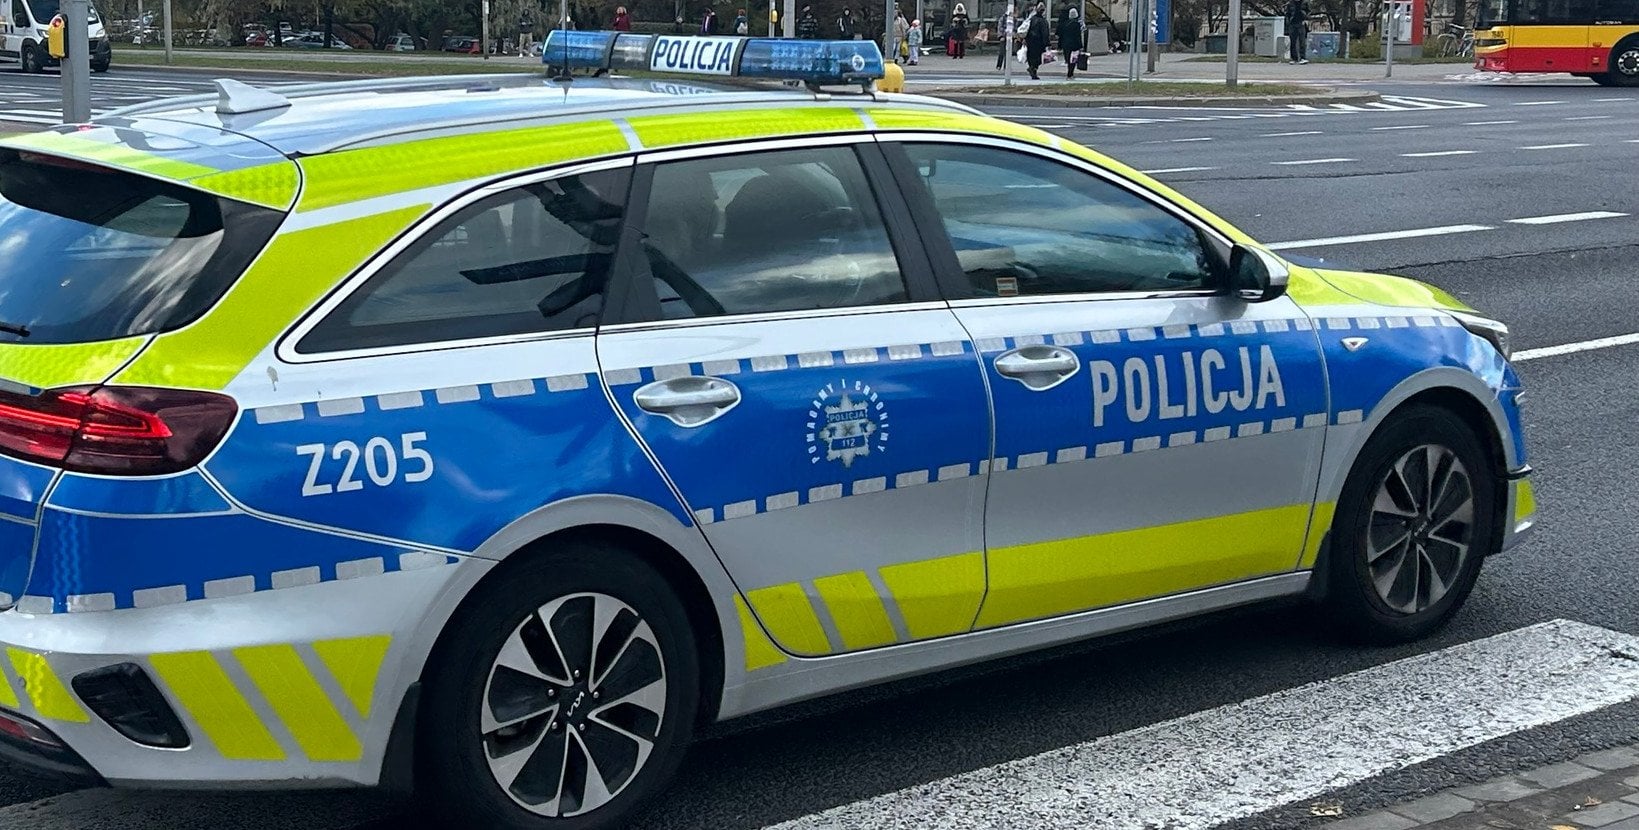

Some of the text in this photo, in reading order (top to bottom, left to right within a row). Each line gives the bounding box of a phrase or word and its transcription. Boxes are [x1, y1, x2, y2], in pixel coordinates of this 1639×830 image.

[653, 39, 733, 71] POLICJA
[1089, 344, 1286, 427] POLICJA
[829, 410, 865, 422] POLICJA
[842, 438, 856, 447] 112
[296, 431, 434, 497] Z205
